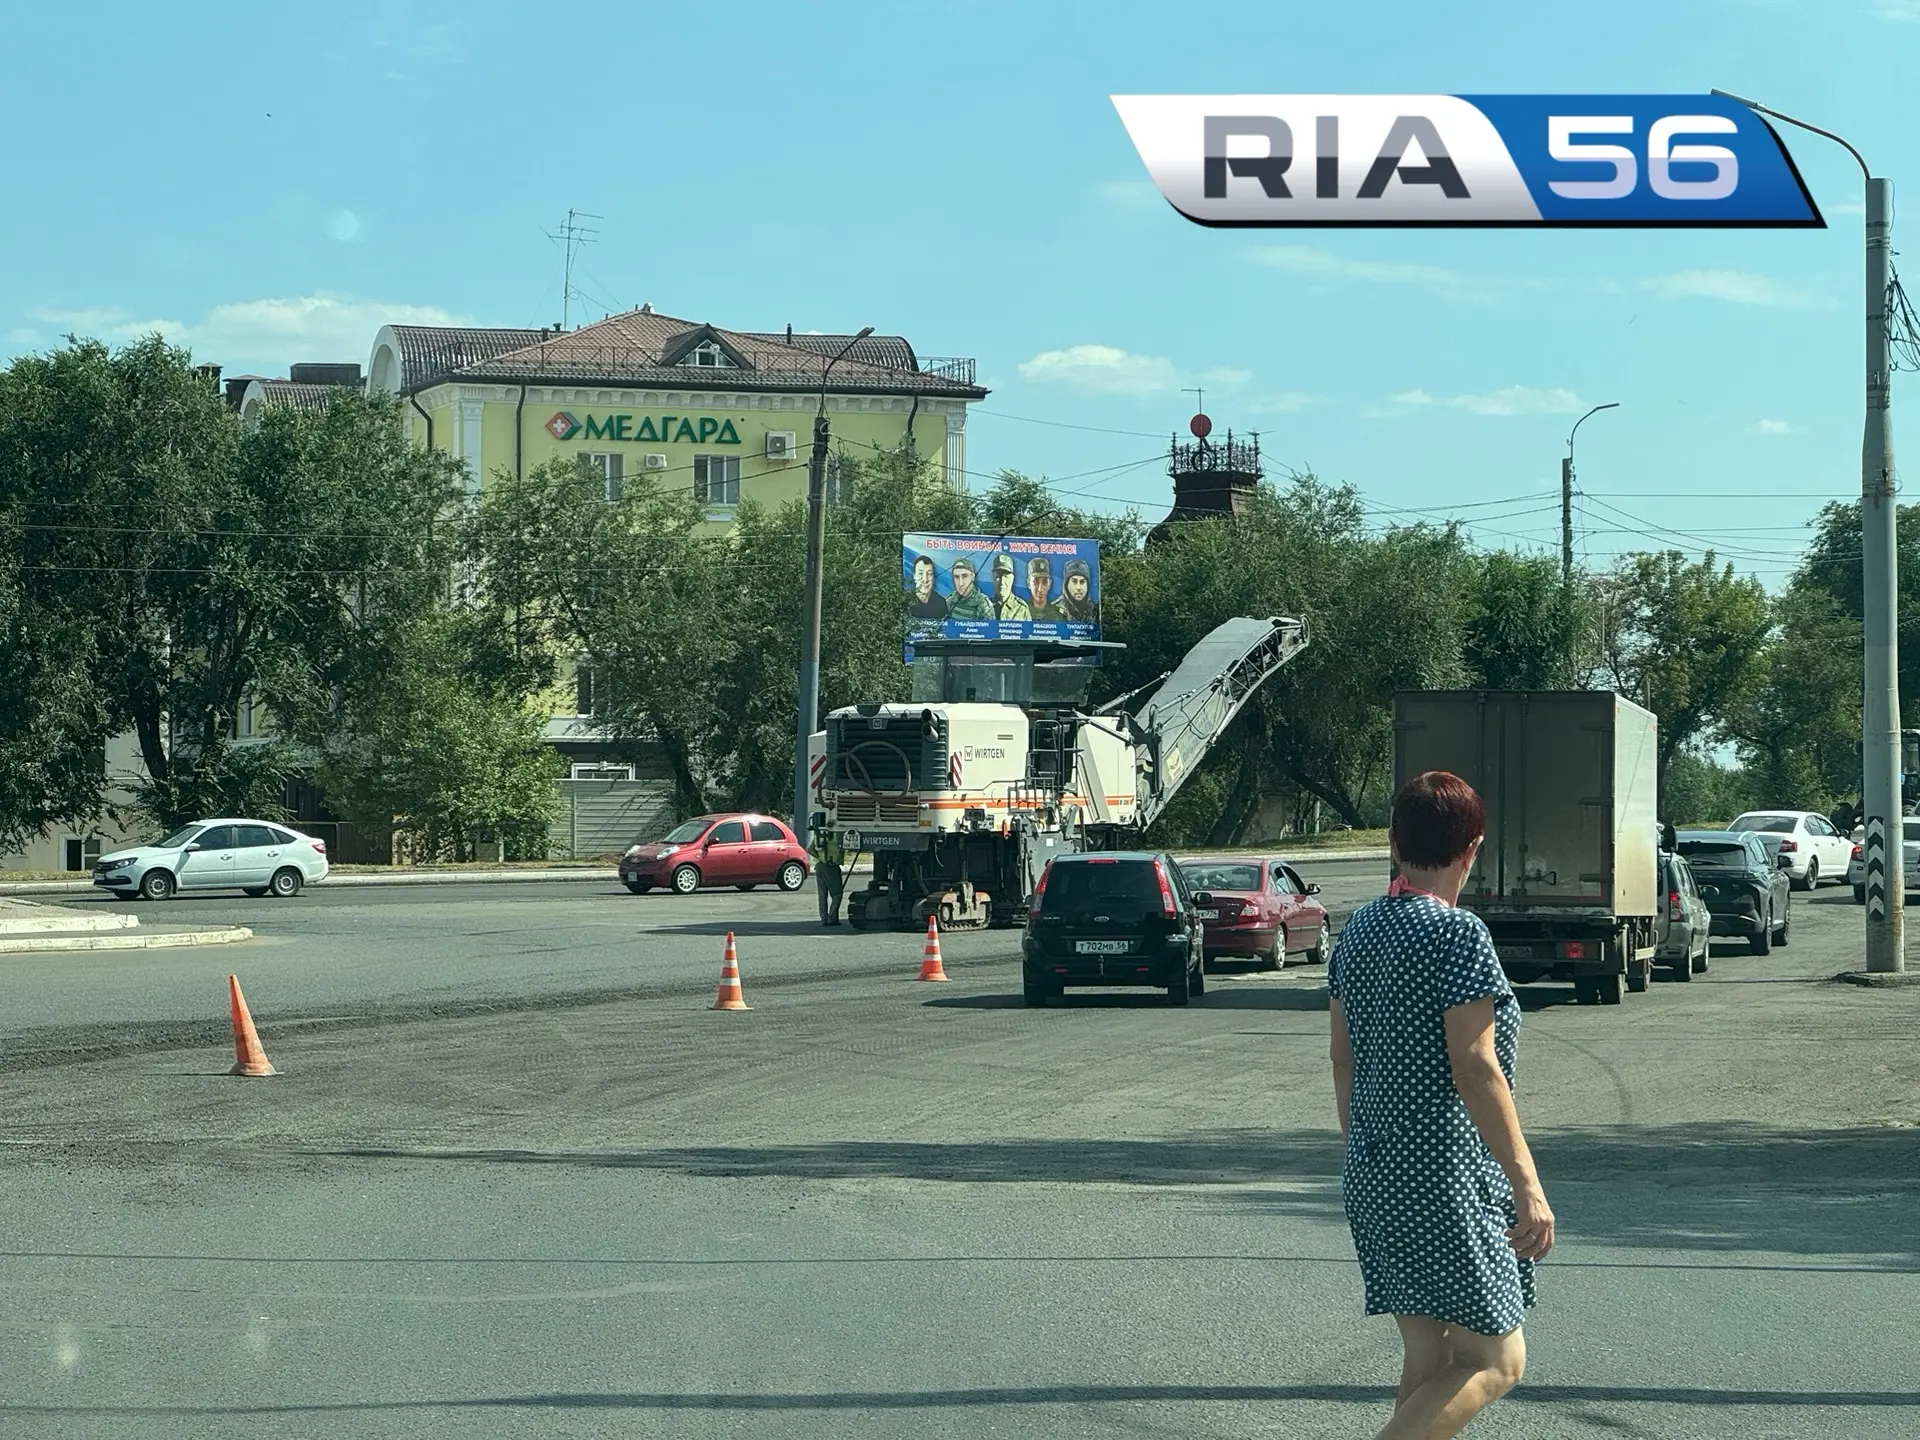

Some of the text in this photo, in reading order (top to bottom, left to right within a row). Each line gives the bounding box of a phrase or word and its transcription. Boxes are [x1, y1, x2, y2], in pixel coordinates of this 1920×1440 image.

[584, 413, 742, 445] МЕДГАРД
[925, 538, 954, 549] БЫТЬ
[956, 540, 1002, 552] ВОИНОМ
[1008, 542, 1039, 553] ЖИТЬ
[1040, 543, 1077, 555] ВЕЧНО!
[974, 747, 1006, 759] WIRTGEN
[862, 837, 900, 846] WIRTGEN
[1116, 941, 1127, 949] 56
